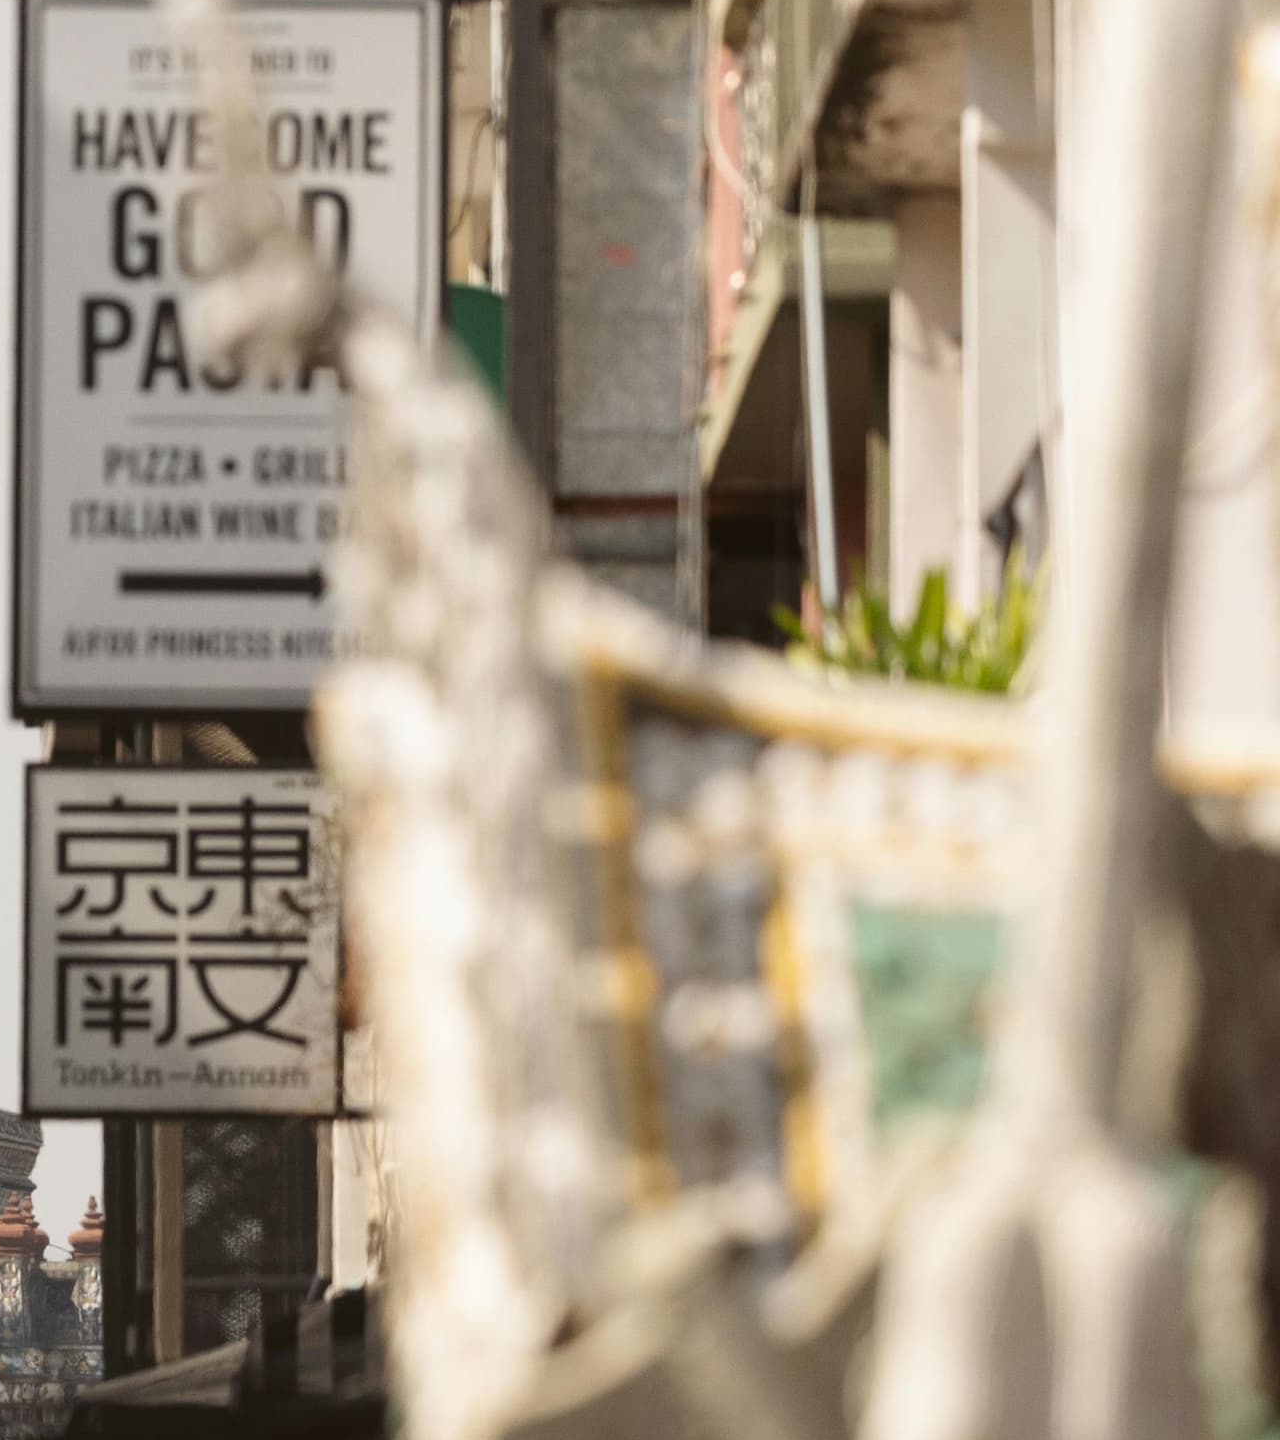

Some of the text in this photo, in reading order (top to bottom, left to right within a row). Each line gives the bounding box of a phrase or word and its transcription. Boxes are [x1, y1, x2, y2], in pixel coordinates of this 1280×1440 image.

[73, 110, 389, 173] HAVE OME
[102, 443, 207, 488] PIZZA
[69, 499, 203, 544] ITALIAN
[209, 499, 303, 544] WINE
